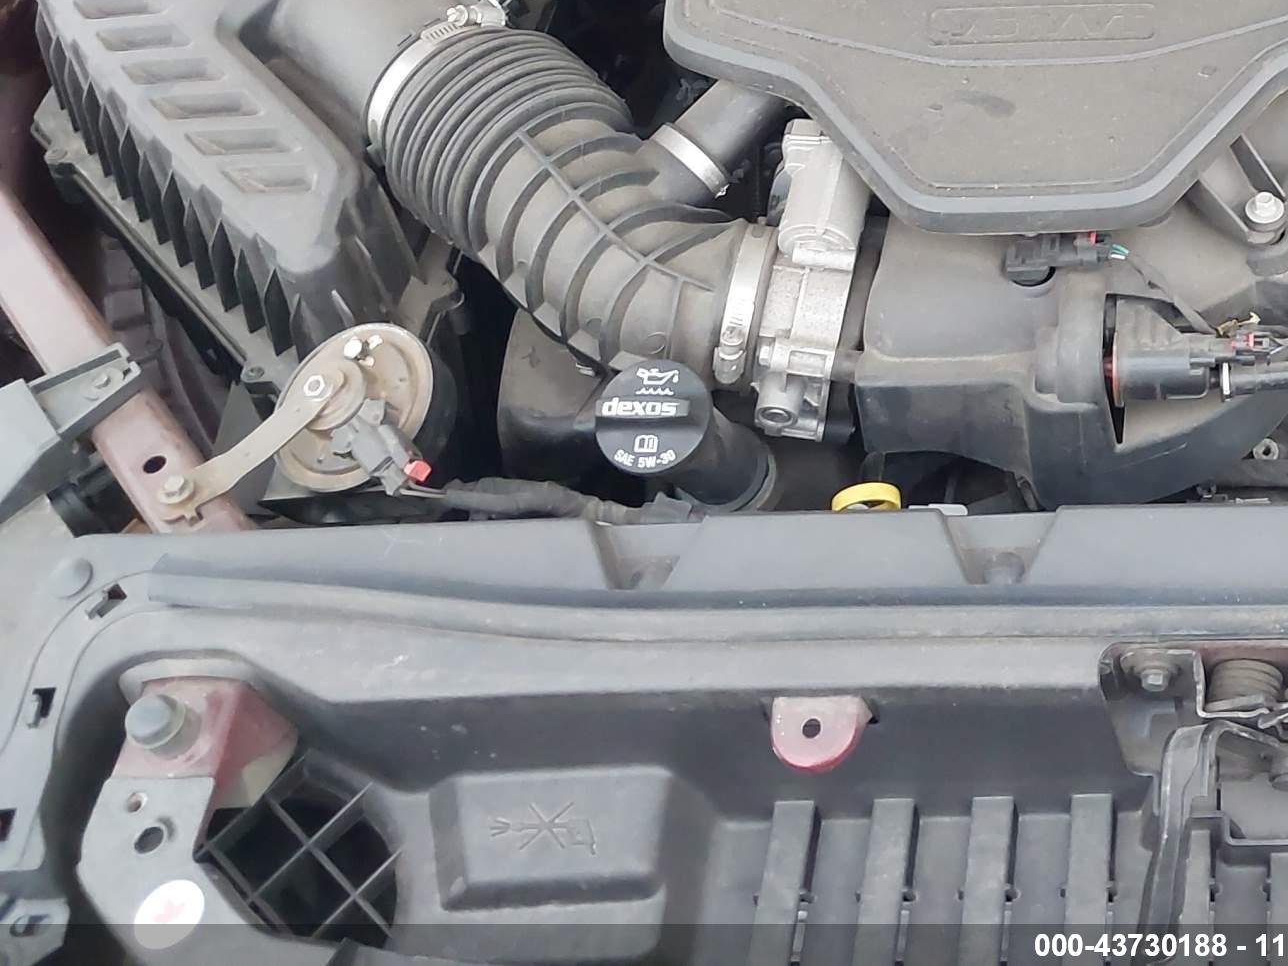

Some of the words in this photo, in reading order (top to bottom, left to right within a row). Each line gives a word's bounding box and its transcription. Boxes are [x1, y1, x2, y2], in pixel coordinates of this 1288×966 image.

[601, 397, 680, 417] dexos
[614, 450, 635, 468] SAE
[638, 449, 677, 469] 5W-30
